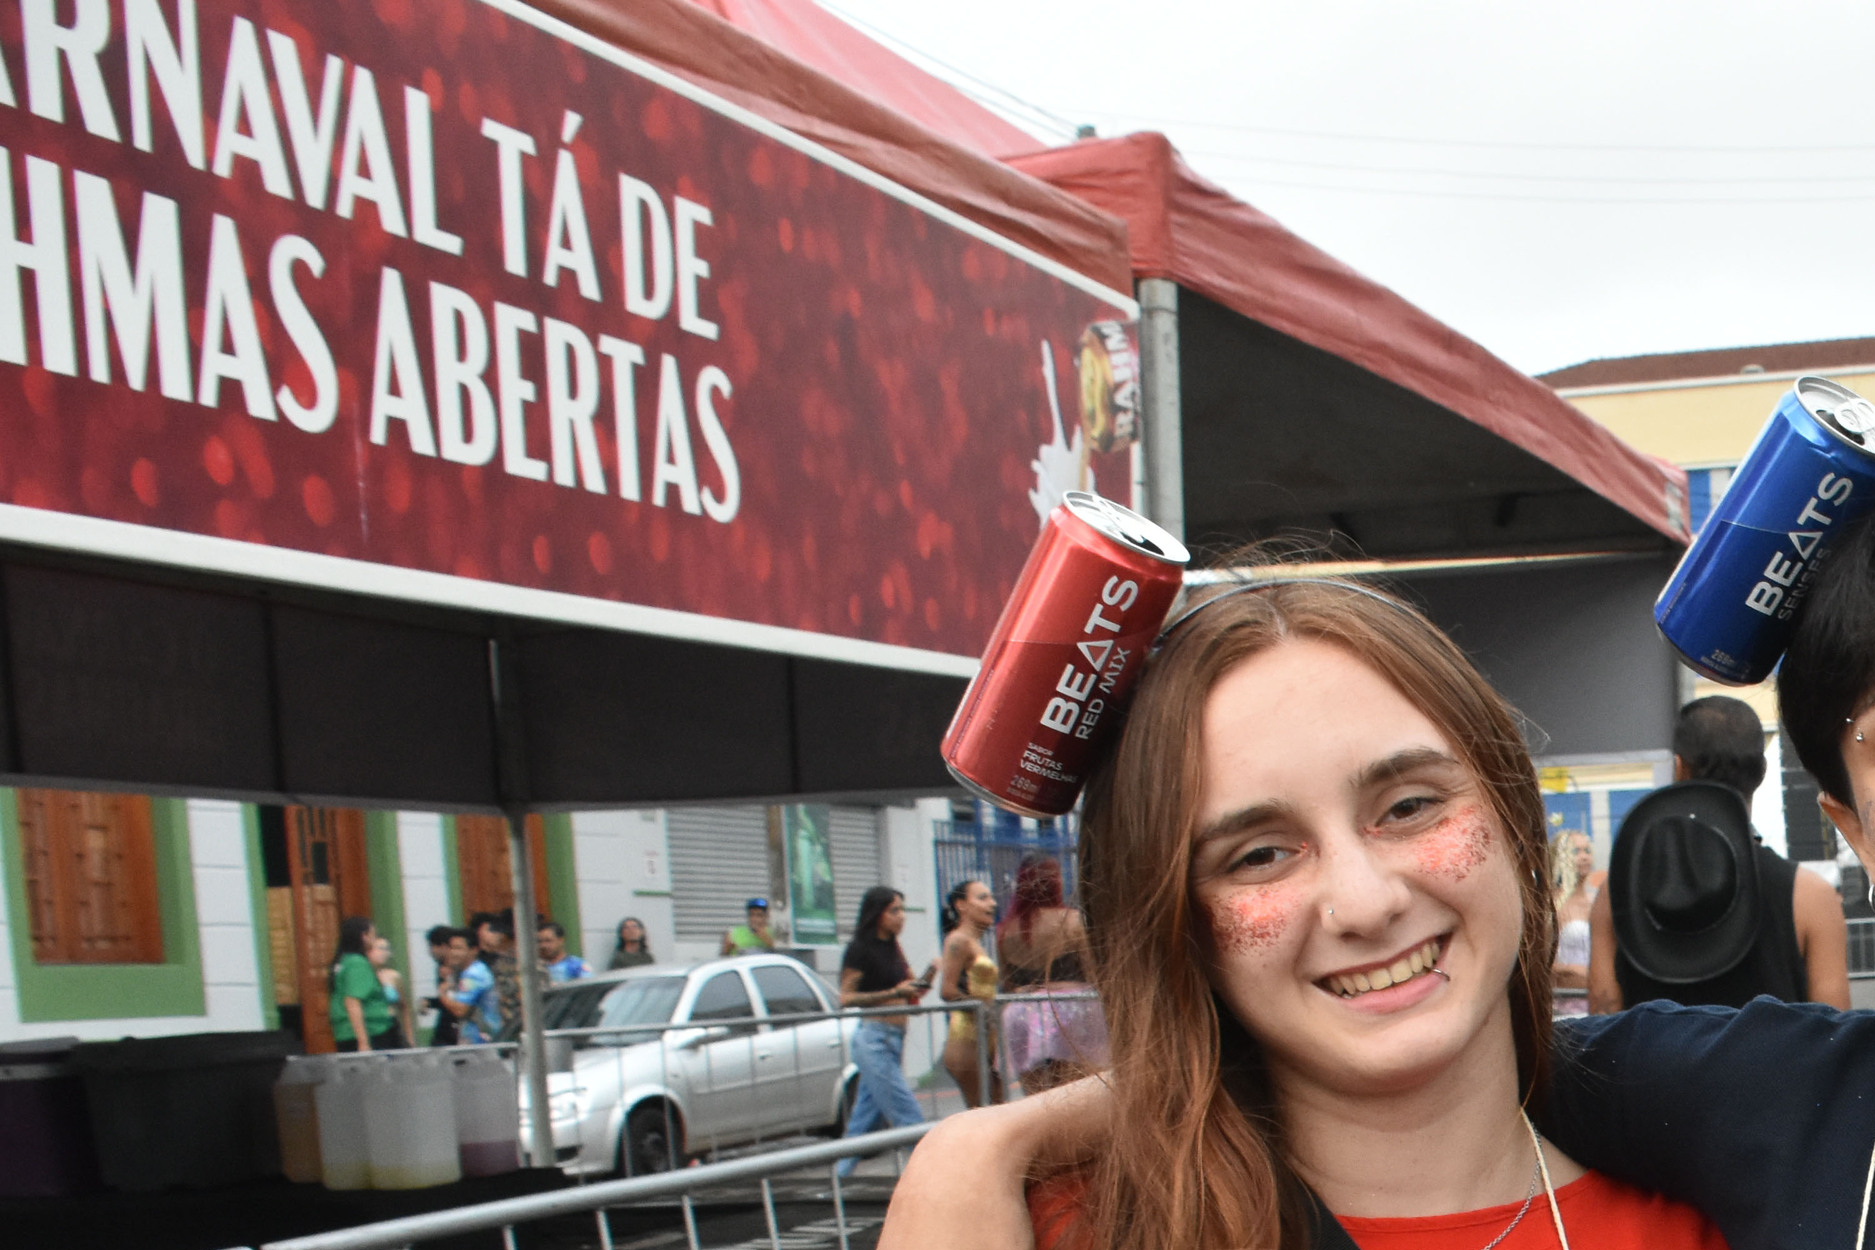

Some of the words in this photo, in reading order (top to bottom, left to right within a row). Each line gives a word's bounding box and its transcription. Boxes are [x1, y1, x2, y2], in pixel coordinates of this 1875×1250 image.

[0, 0, 464, 256] RNAVAL
[481, 109, 603, 303] TÁ
[618, 172, 720, 340] DE
[369, 267, 742, 524] ABERTAS
[1745, 472, 1854, 616] BEATS
[1040, 574, 1140, 735] BEATS
[1075, 698, 1104, 740] RED
[1099, 647, 1132, 694] MIX
[1023, 750, 1064, 771] FRUTAS
